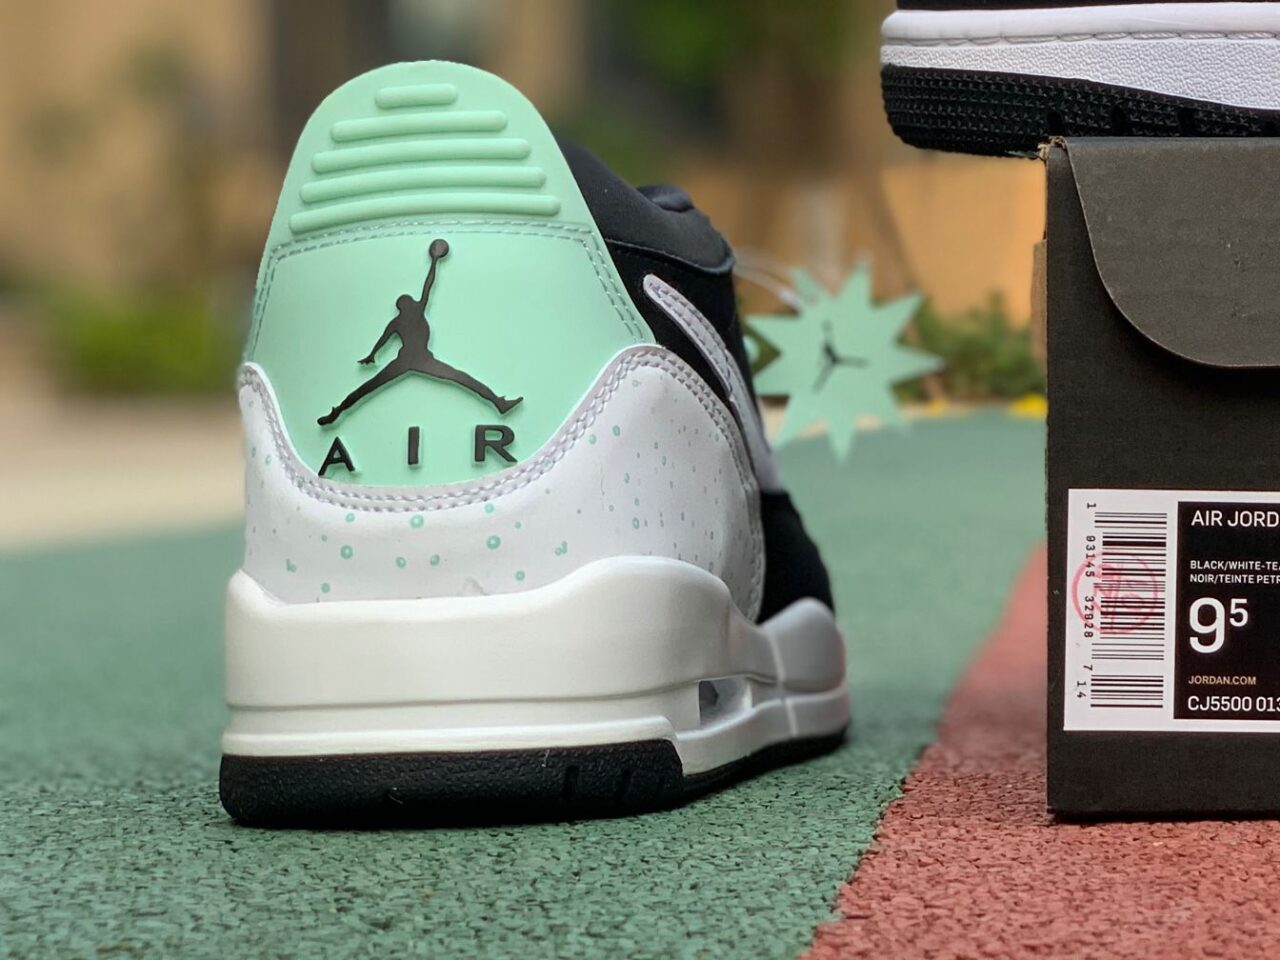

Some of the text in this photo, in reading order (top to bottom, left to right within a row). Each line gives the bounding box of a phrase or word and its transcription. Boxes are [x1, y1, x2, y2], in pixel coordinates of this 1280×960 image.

[318, 424, 518, 477] AIR
[1191, 510, 1223, 527] AIR
[1190, 573, 1255, 584] NOIR/TEINTE
[1188, 675, 1257, 685] JORDAN.COM
[1187, 696, 1252, 711] CJ5500
